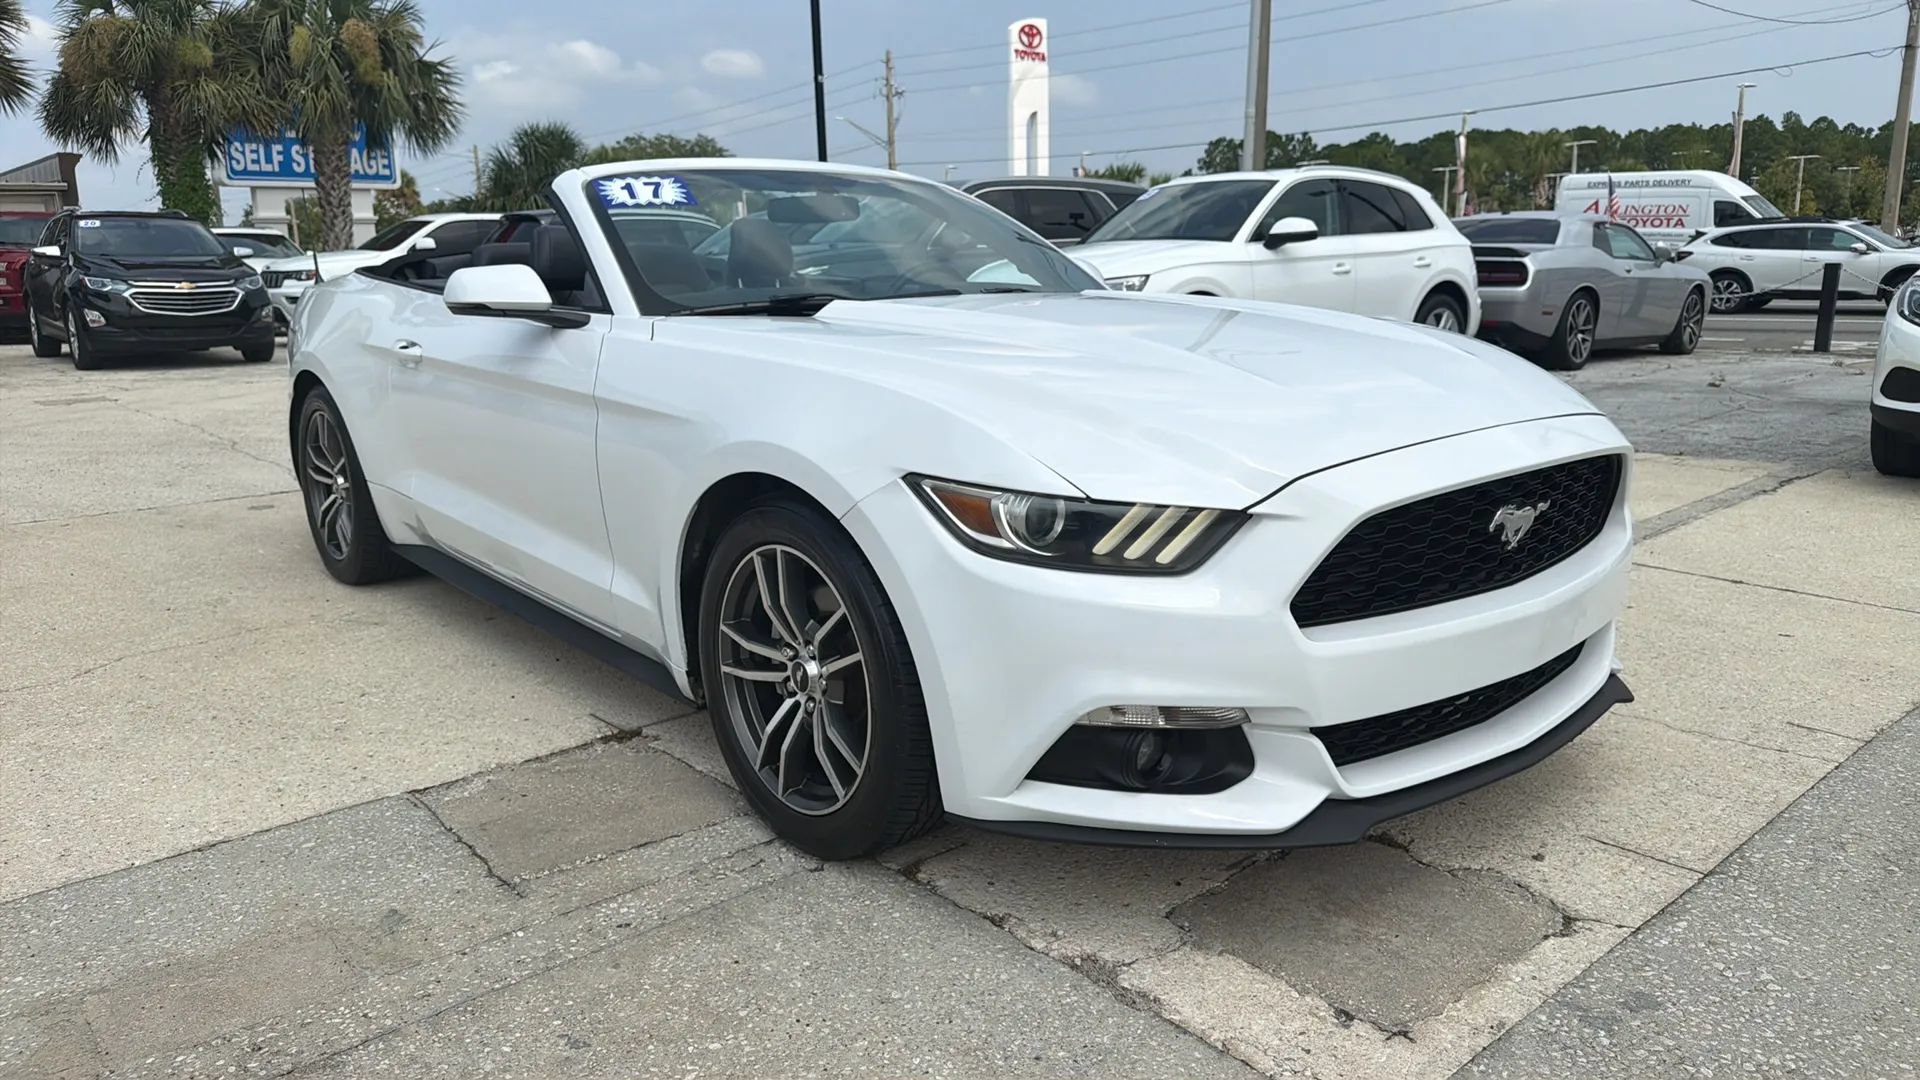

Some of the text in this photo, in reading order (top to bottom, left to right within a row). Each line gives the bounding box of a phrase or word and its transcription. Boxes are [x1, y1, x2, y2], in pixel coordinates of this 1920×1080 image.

[1014, 49, 1046, 62] TOYOTA
[230, 141, 391, 175] SELF STAGE
[620, 181, 662, 200] 17
[1624, 180, 1650, 188] PARTS
[1652, 178, 1692, 187] DELIVERY
